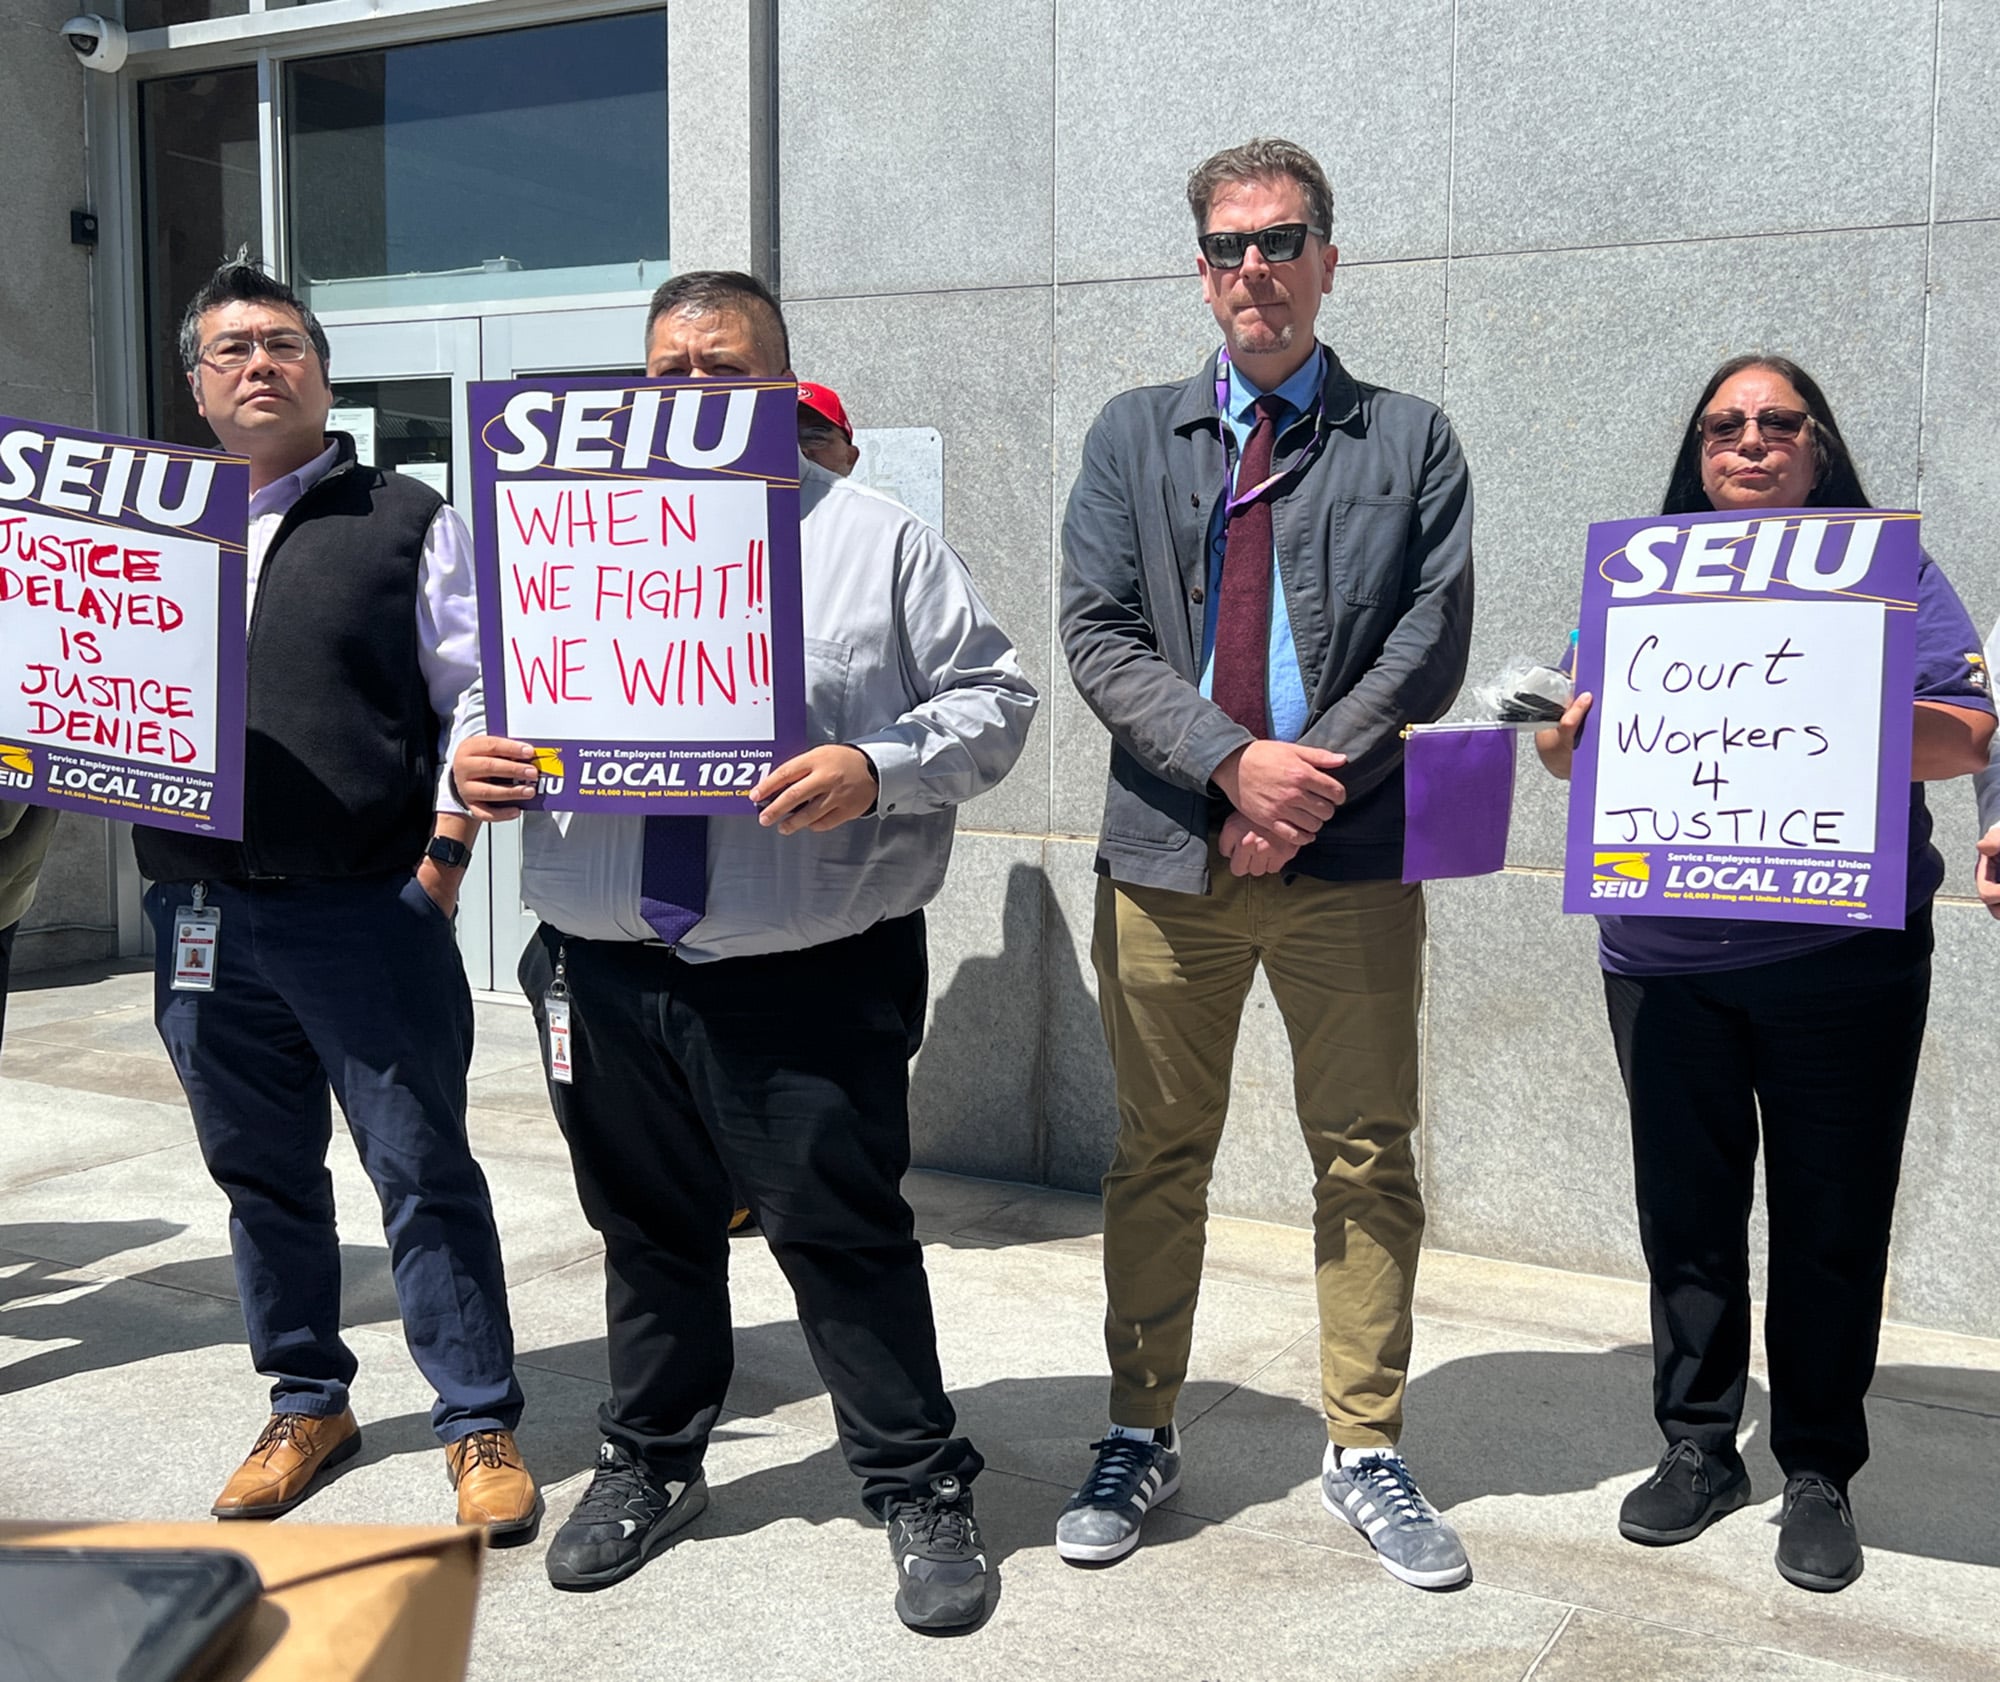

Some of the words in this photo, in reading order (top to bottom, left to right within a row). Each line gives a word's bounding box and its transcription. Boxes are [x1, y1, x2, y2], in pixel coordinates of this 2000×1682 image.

[496, 390, 758, 472] SEIU
[0, 430, 217, 527] SEIU
[506, 489, 697, 547] WHEN
[0, 517, 163, 582] JUSTICE
[1611, 519, 1883, 598] SEIU
[0, 567, 184, 632] DELAYED
[512, 561, 575, 614] WE
[595, 539, 763, 621] FIGHT!!
[60, 627, 102, 663] IS
[512, 636, 592, 704] WE
[613, 632, 770, 705] WIN!!
[1627, 635, 1805, 692] Court
[20, 664, 195, 718] JUSTICE
[28, 702, 197, 763] DENIED
[579, 748, 611, 758] Service
[613, 749, 667, 761] Employees
[669, 750, 737, 759] International
[740, 750, 773, 758] Union
[1618, 714, 1829, 756] Workers
[0, 769, 34, 789] EIU
[48, 752, 78, 765] Service
[79, 758, 125, 773] Employees
[127, 767, 184, 784] International
[186, 776, 214, 788] Union
[48, 765, 140, 799] LOCAL
[150, 783, 212, 812] 1021
[580, 762, 686, 787] LOCAL
[698, 762, 772, 787] 1021
[1692, 761, 1729, 800] 4
[1605, 808, 1845, 847] JUSTICE
[1665, 865, 1780, 892] LOCAL
[1792, 870, 1870, 897] 1021
[1667, 853, 1704, 862] Service
[1705, 854, 1761, 866] Employees
[1764, 856, 1835, 868] International
[1837, 860, 1871, 870] Union
[1589, 880, 1649, 898] SEIU
